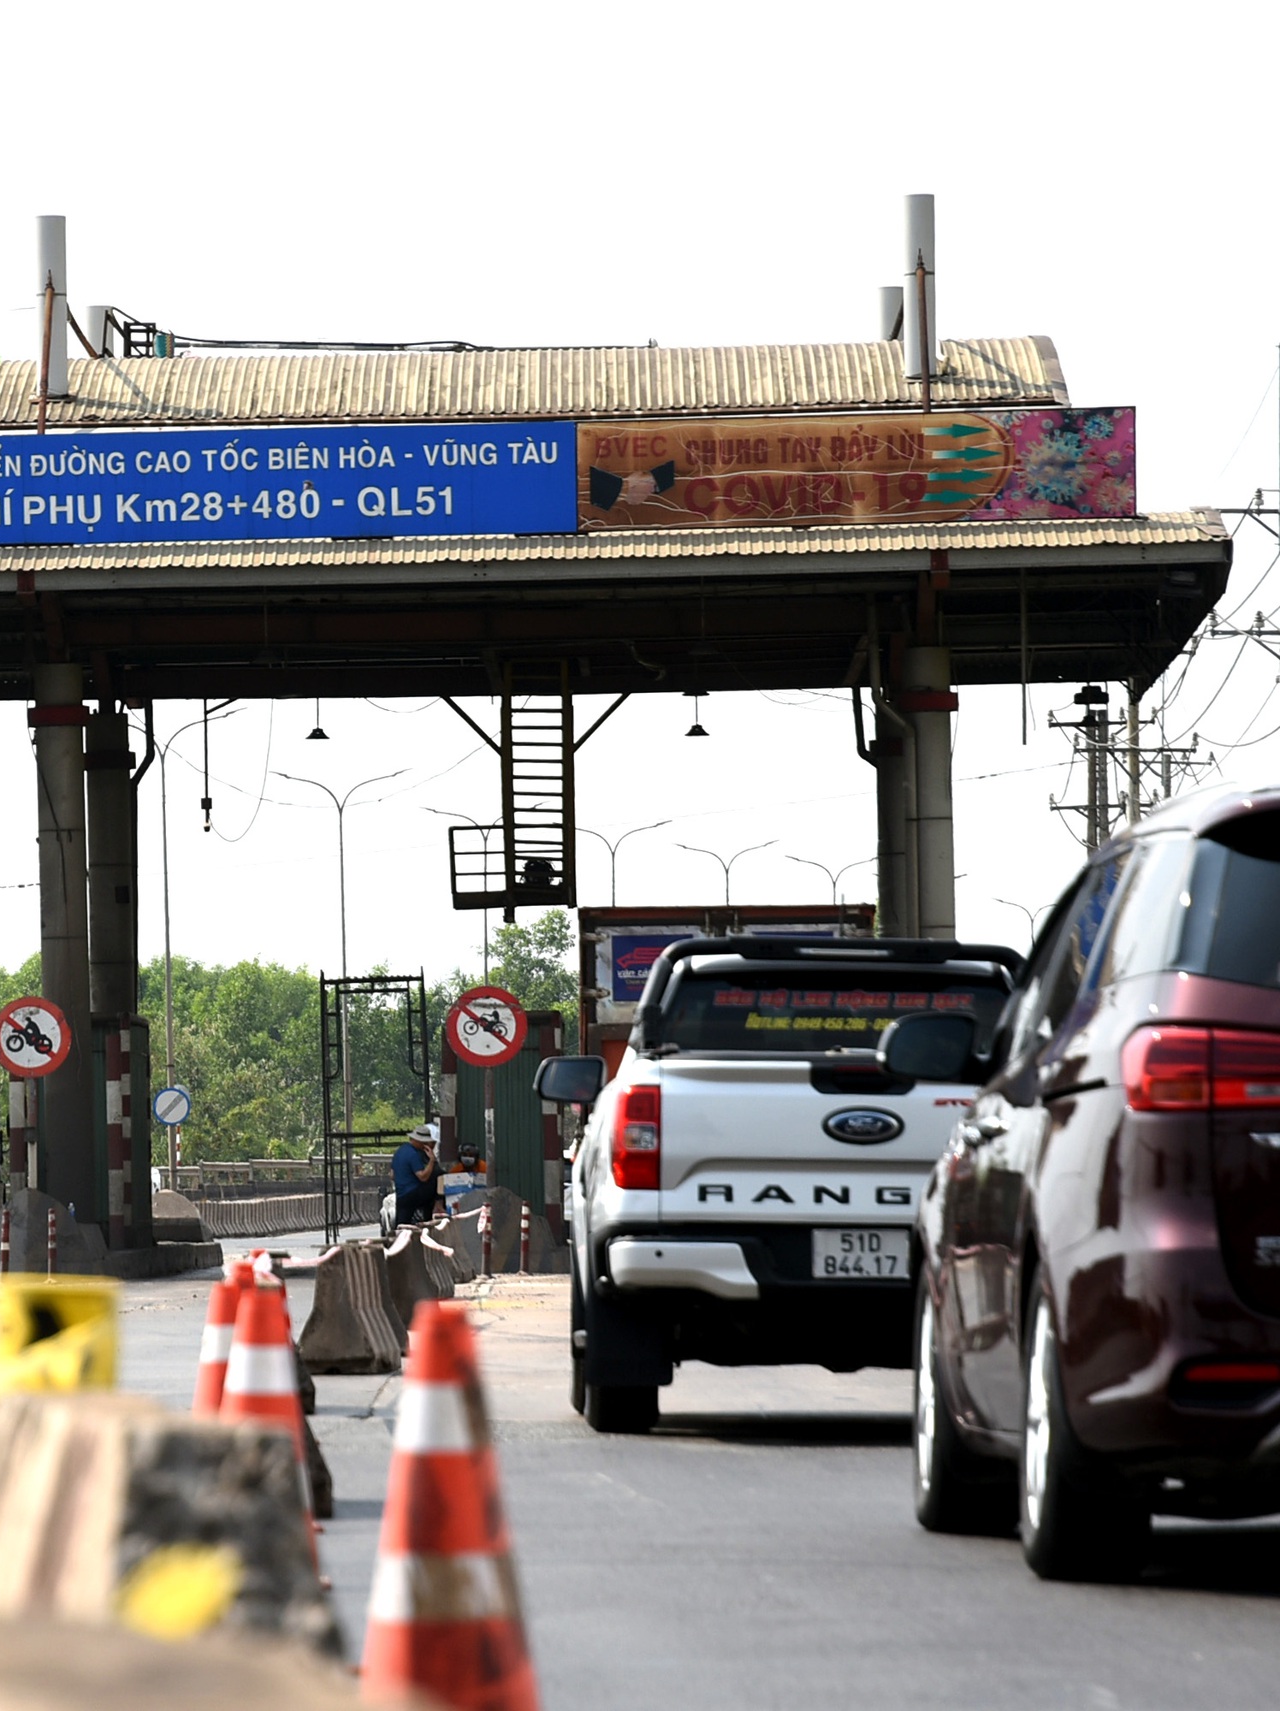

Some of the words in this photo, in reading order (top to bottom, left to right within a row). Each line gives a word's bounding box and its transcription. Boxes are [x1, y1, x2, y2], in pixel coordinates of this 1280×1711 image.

[30, 445, 126, 477] ĐƯỜNG
[135, 450, 192, 474] CAO
[202, 438, 259, 472] TỐC
[268, 442, 330, 470] BIÊN
[338, 438, 396, 469] HÒA
[423, 438, 498, 467] VŨNG
[508, 436, 558, 465] TÀU
[596, 435, 668, 459] BVEC
[686, 436, 769, 466] CHUNG
[778, 434, 827, 464] TAY
[831, 424, 878, 463] ĐẨY
[887, 428, 925, 460] LÙI
[23, 494, 102, 533] PHỤ
[116, 488, 320, 523] Km28+480
[331, 499, 345, 507] -
[357, 486, 453, 517] QL51
[684, 471, 928, 517] COVID-19
[697, 1183, 912, 1205] RANG
[840, 1233, 882, 1253] 51D
[824, 1255, 898, 1276] 844.17
